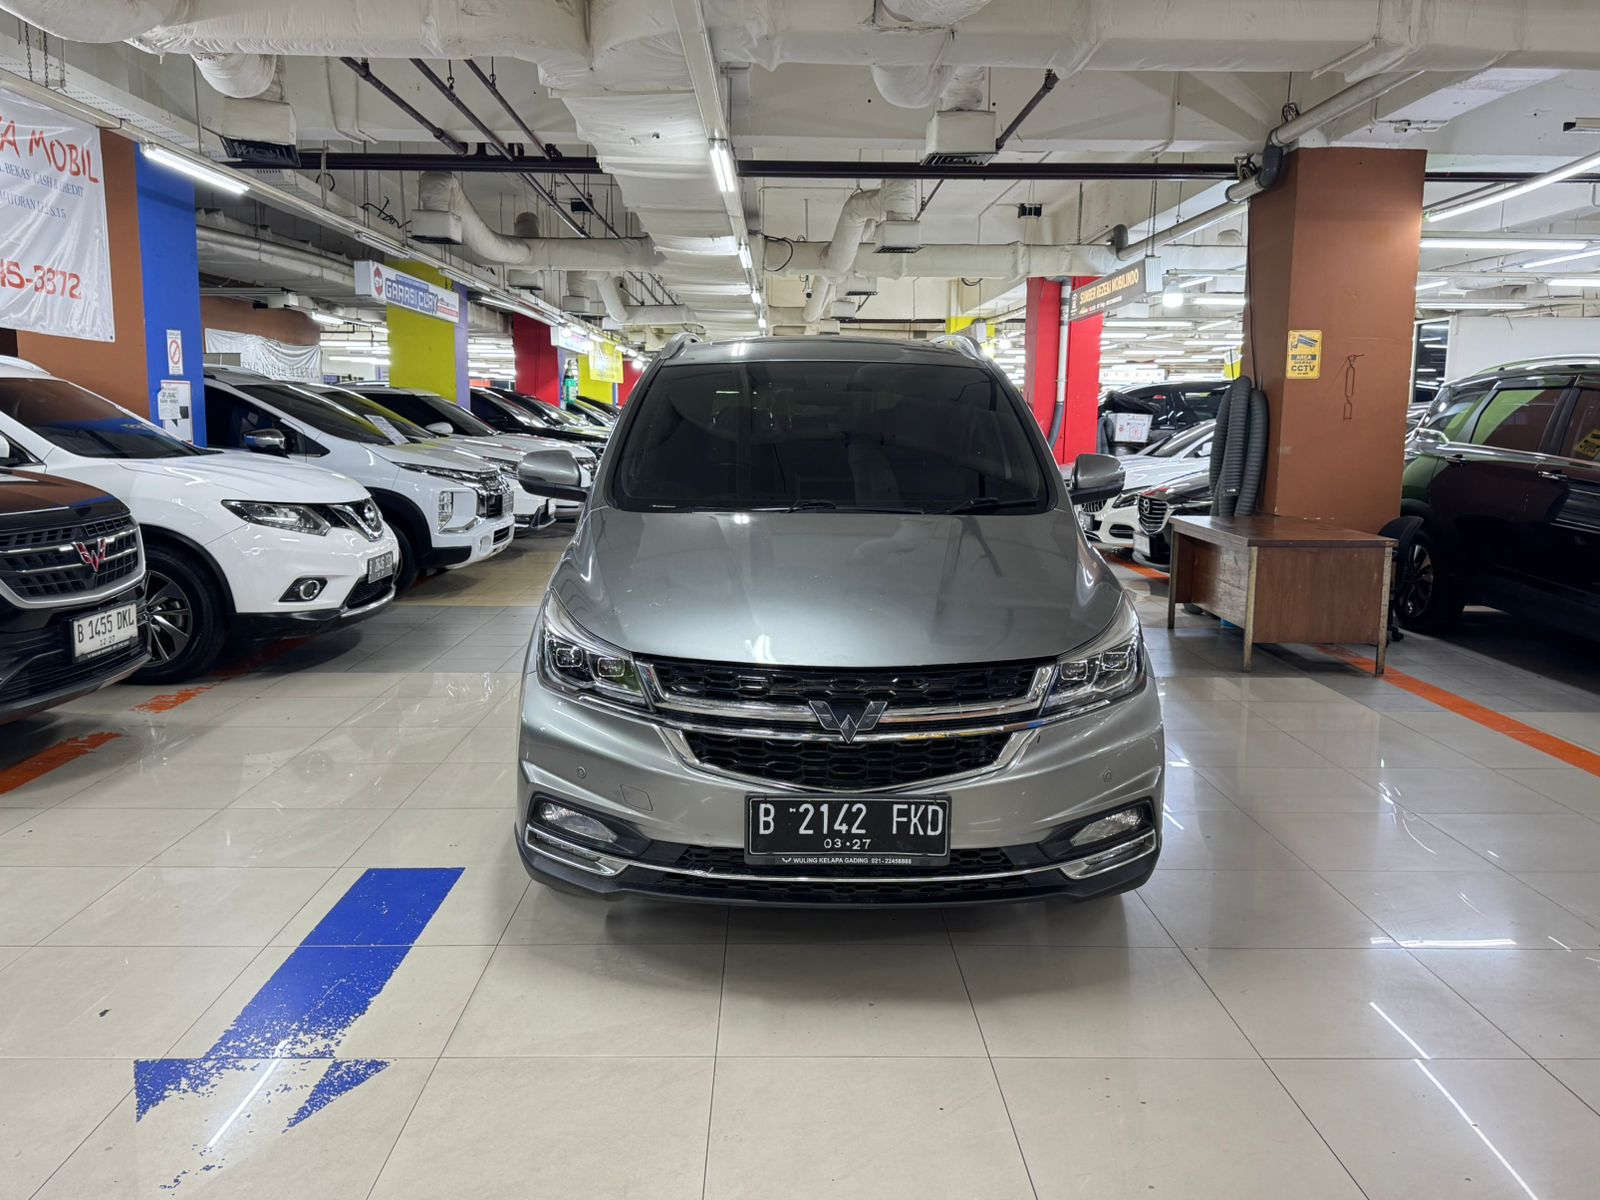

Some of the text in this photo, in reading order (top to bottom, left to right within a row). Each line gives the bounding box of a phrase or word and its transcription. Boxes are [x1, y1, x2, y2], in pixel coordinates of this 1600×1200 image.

[0, 114, 99, 184] A MOBIL
[4, 162, 31, 180] BEKAS
[385, 280, 418, 308] GARASI
[1080, 287, 1096, 305] SUMBER
[1112, 268, 1139, 293] MOBILINDO
[77, 608, 135, 643] B 1455 DKL
[758, 803, 944, 836] B 2142 FKD
[793, 857, 818, 865] WULING
[819, 857, 844, 865] KELAPA
[844, 857, 869, 865] GADING
